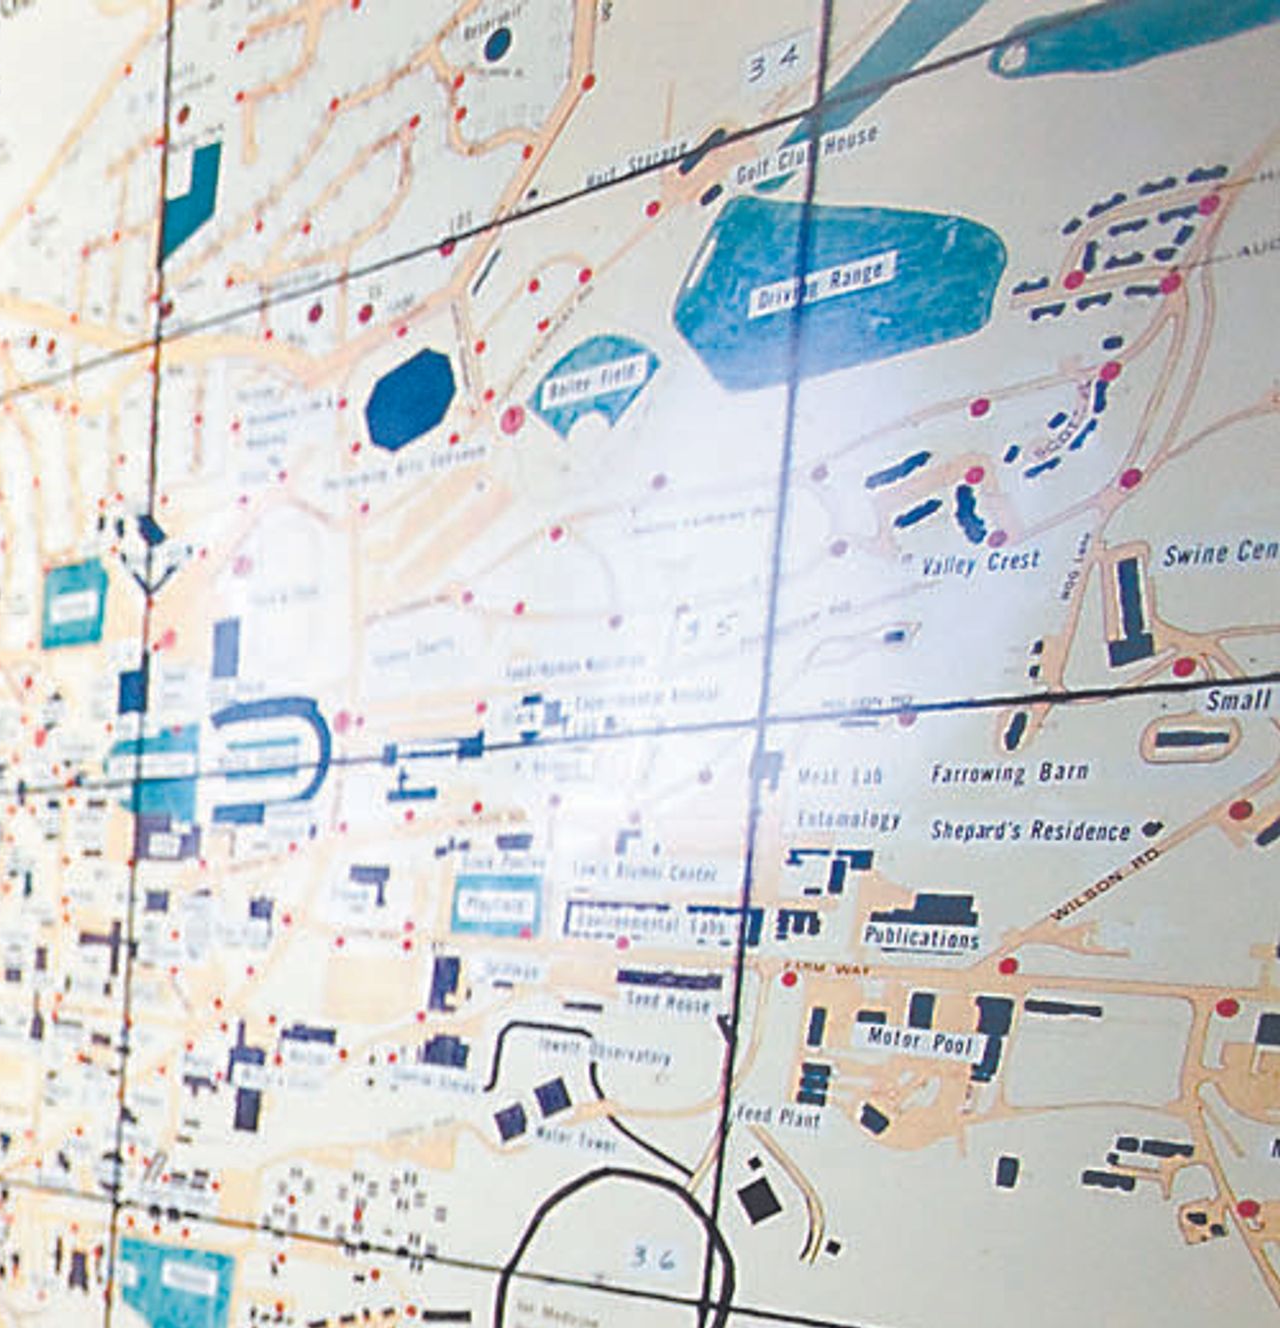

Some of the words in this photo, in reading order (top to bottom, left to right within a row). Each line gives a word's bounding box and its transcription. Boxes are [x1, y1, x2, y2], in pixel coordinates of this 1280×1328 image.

[736, 160, 769, 186] Golf
[778, 142, 814, 171] Clu
[824, 125, 879, 156] House
[829, 261, 883, 288] Range
[923, 558, 976, 579] Valley
[988, 550, 1040, 572] Crest
[1163, 544, 1228, 568] Swine
[1206, 688, 1272, 711] Small
[932, 763, 1025, 787] Farrowing
[1039, 762, 1089, 781] Barn
[797, 808, 902, 831] Entomology
[932, 820, 1021, 845] Shepard's
[1031, 820, 1130, 842] Residence
[1050, 870, 1124, 922] WILSON
[1131, 846, 1161, 872] RD
[864, 924, 981, 953] Publications
[868, 1026, 919, 1049] Motor
[932, 1034, 973, 1054] Pool
[780, 1109, 821, 1129] Plant
